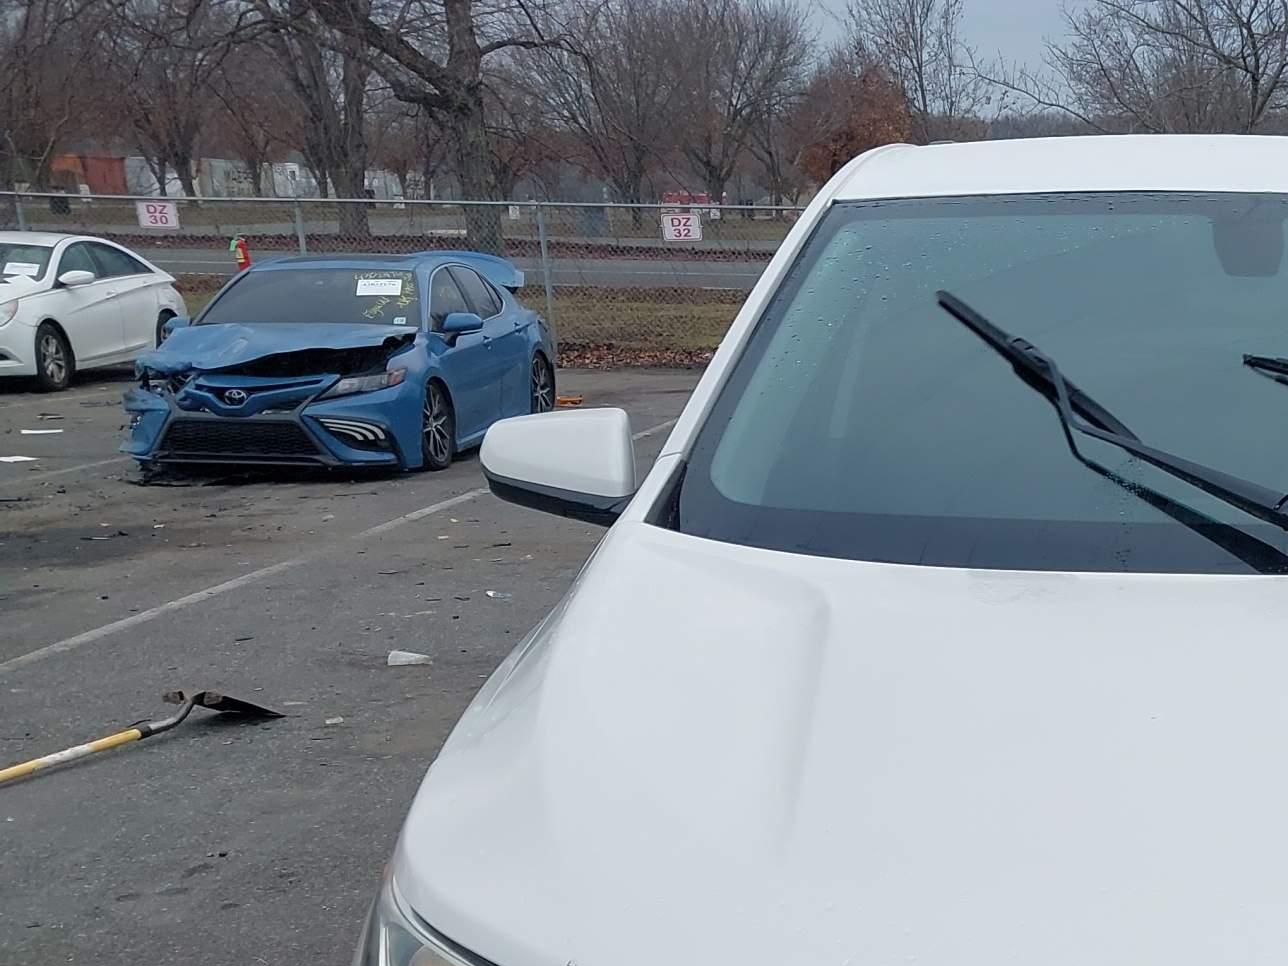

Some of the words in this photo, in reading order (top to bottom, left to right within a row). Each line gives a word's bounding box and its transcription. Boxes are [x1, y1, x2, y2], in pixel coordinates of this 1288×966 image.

[146, 204, 168, 214] DZ
[149, 215, 169, 225] 30
[671, 217, 692, 227] DZ
[673, 228, 692, 237] 32
